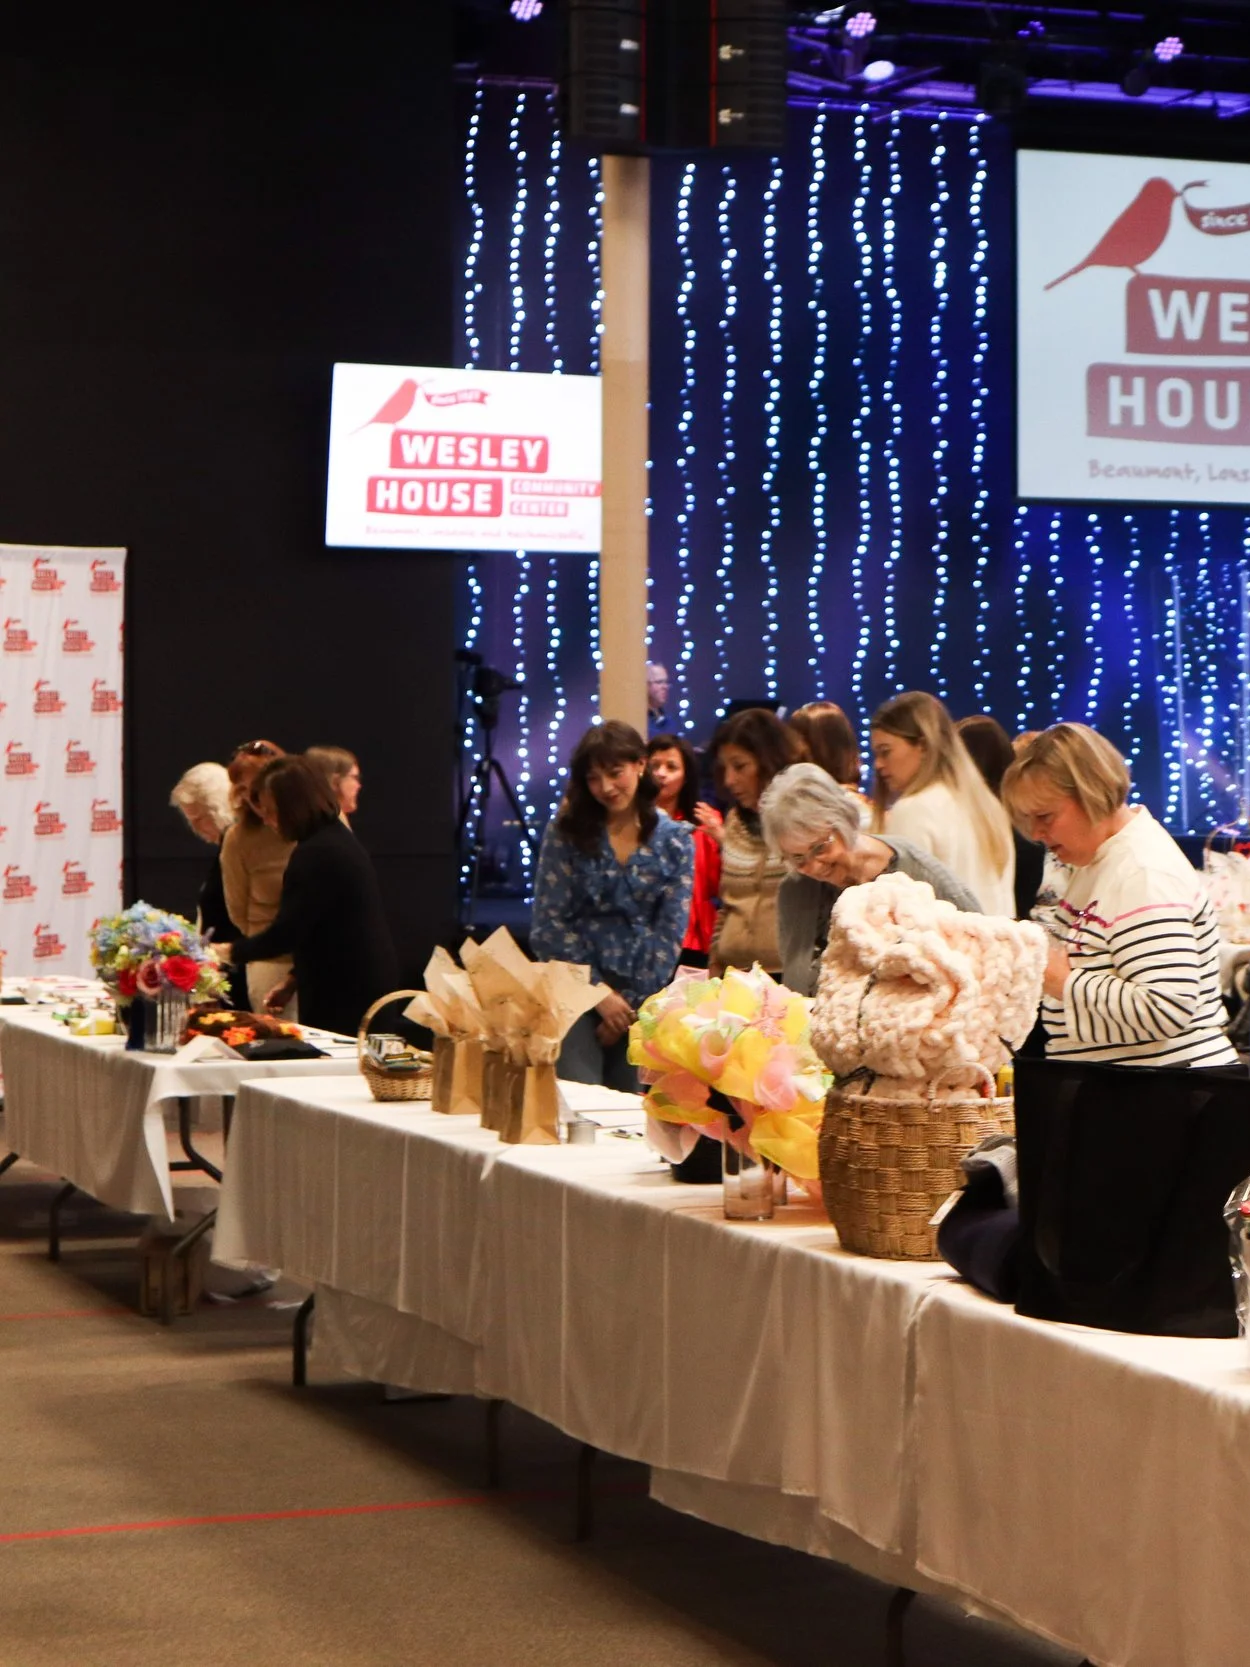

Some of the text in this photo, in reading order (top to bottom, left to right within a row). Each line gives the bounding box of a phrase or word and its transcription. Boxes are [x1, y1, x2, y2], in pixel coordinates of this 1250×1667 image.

[1200, 211, 1248, 229] since
[400, 434, 543, 469] WESLEY
[1088, 459, 1200, 483] Beaumont,
[375, 480, 492, 512] HOUSE
